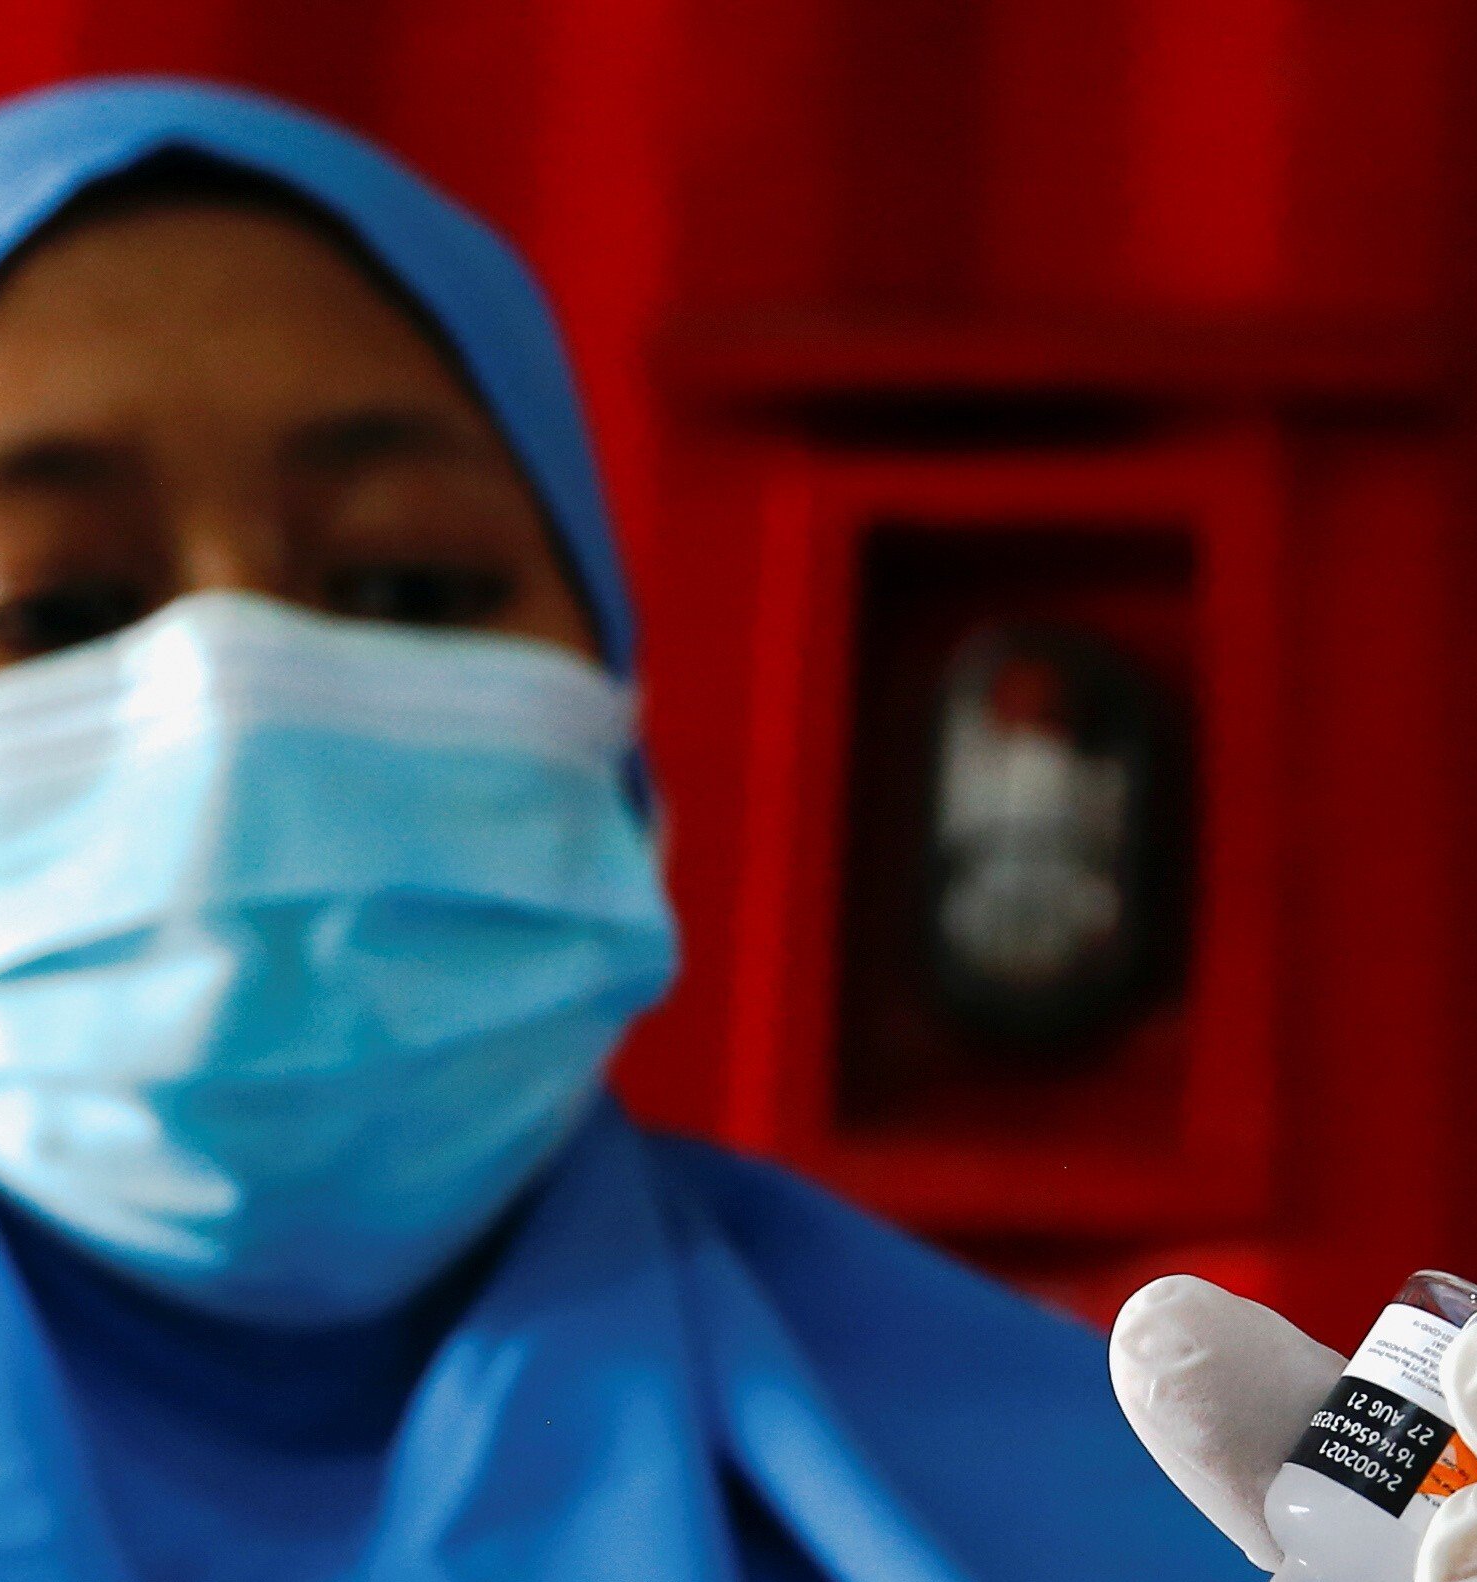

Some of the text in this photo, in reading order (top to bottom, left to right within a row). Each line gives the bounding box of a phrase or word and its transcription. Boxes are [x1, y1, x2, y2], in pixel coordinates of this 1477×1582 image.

[1346, 1391, 1435, 1446] 27 AUG 21
[1318, 1439, 1403, 1492] 24002021
